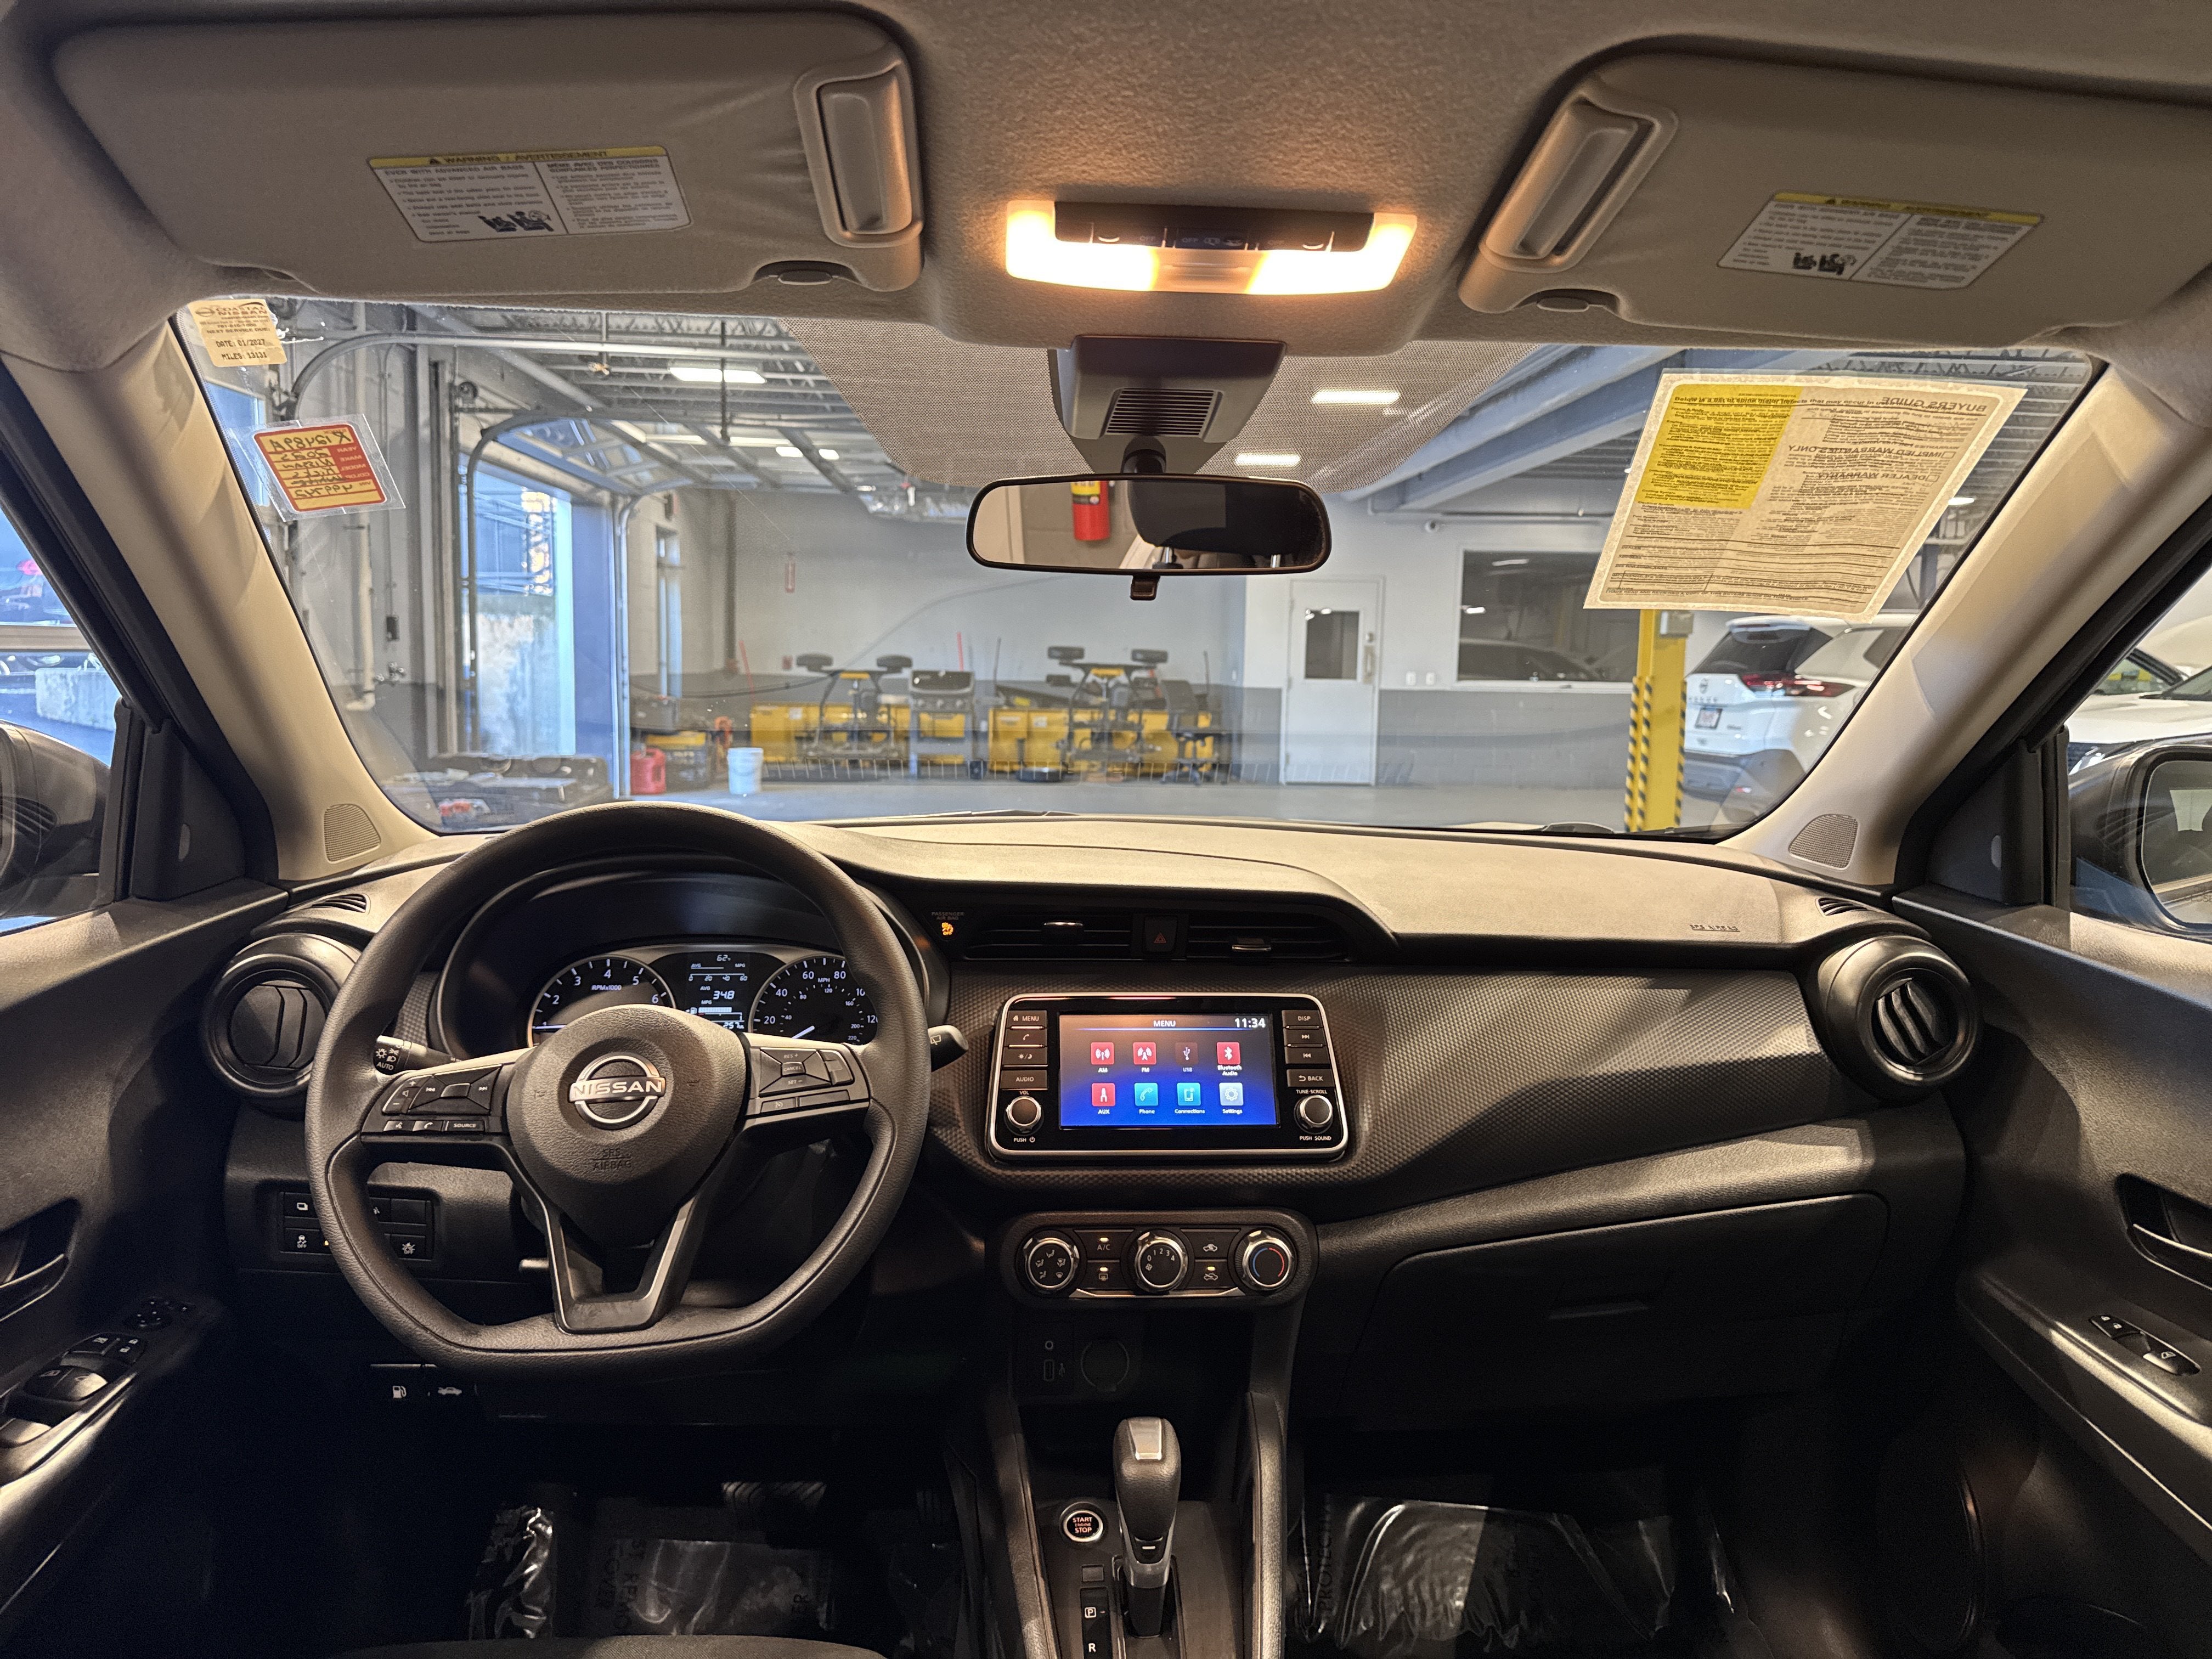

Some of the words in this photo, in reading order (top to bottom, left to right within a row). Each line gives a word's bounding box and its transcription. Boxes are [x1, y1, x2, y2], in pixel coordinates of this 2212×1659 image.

[216, 340, 236, 348] DATE:
[222, 352, 245, 360] MILES:
[247, 351, 268, 359] 13131
[603, 969, 611, 979] 4
[802, 971, 815, 979] 60
[833, 970, 847, 979] 80
[574, 976, 581, 986] 3
[633, 975, 640, 986] 5
[775, 989, 788, 997] 40
[856, 988, 866, 996] 10
[552, 995, 560, 1005] 2
[651, 994, 659, 1003] 6
[867, 1015, 878, 1023] 12
[1234, 1018, 1266, 1029] 11:34
[376, 1062, 394, 1071] AUTO
[572, 1080, 663, 1097] NISSAN
[602, 1148, 621, 1158] SRS
[592, 1160, 632, 1170] AIRBAG
[1087, 1609, 1094, 1617] P
[1088, 1643, 1096, 1653] R
